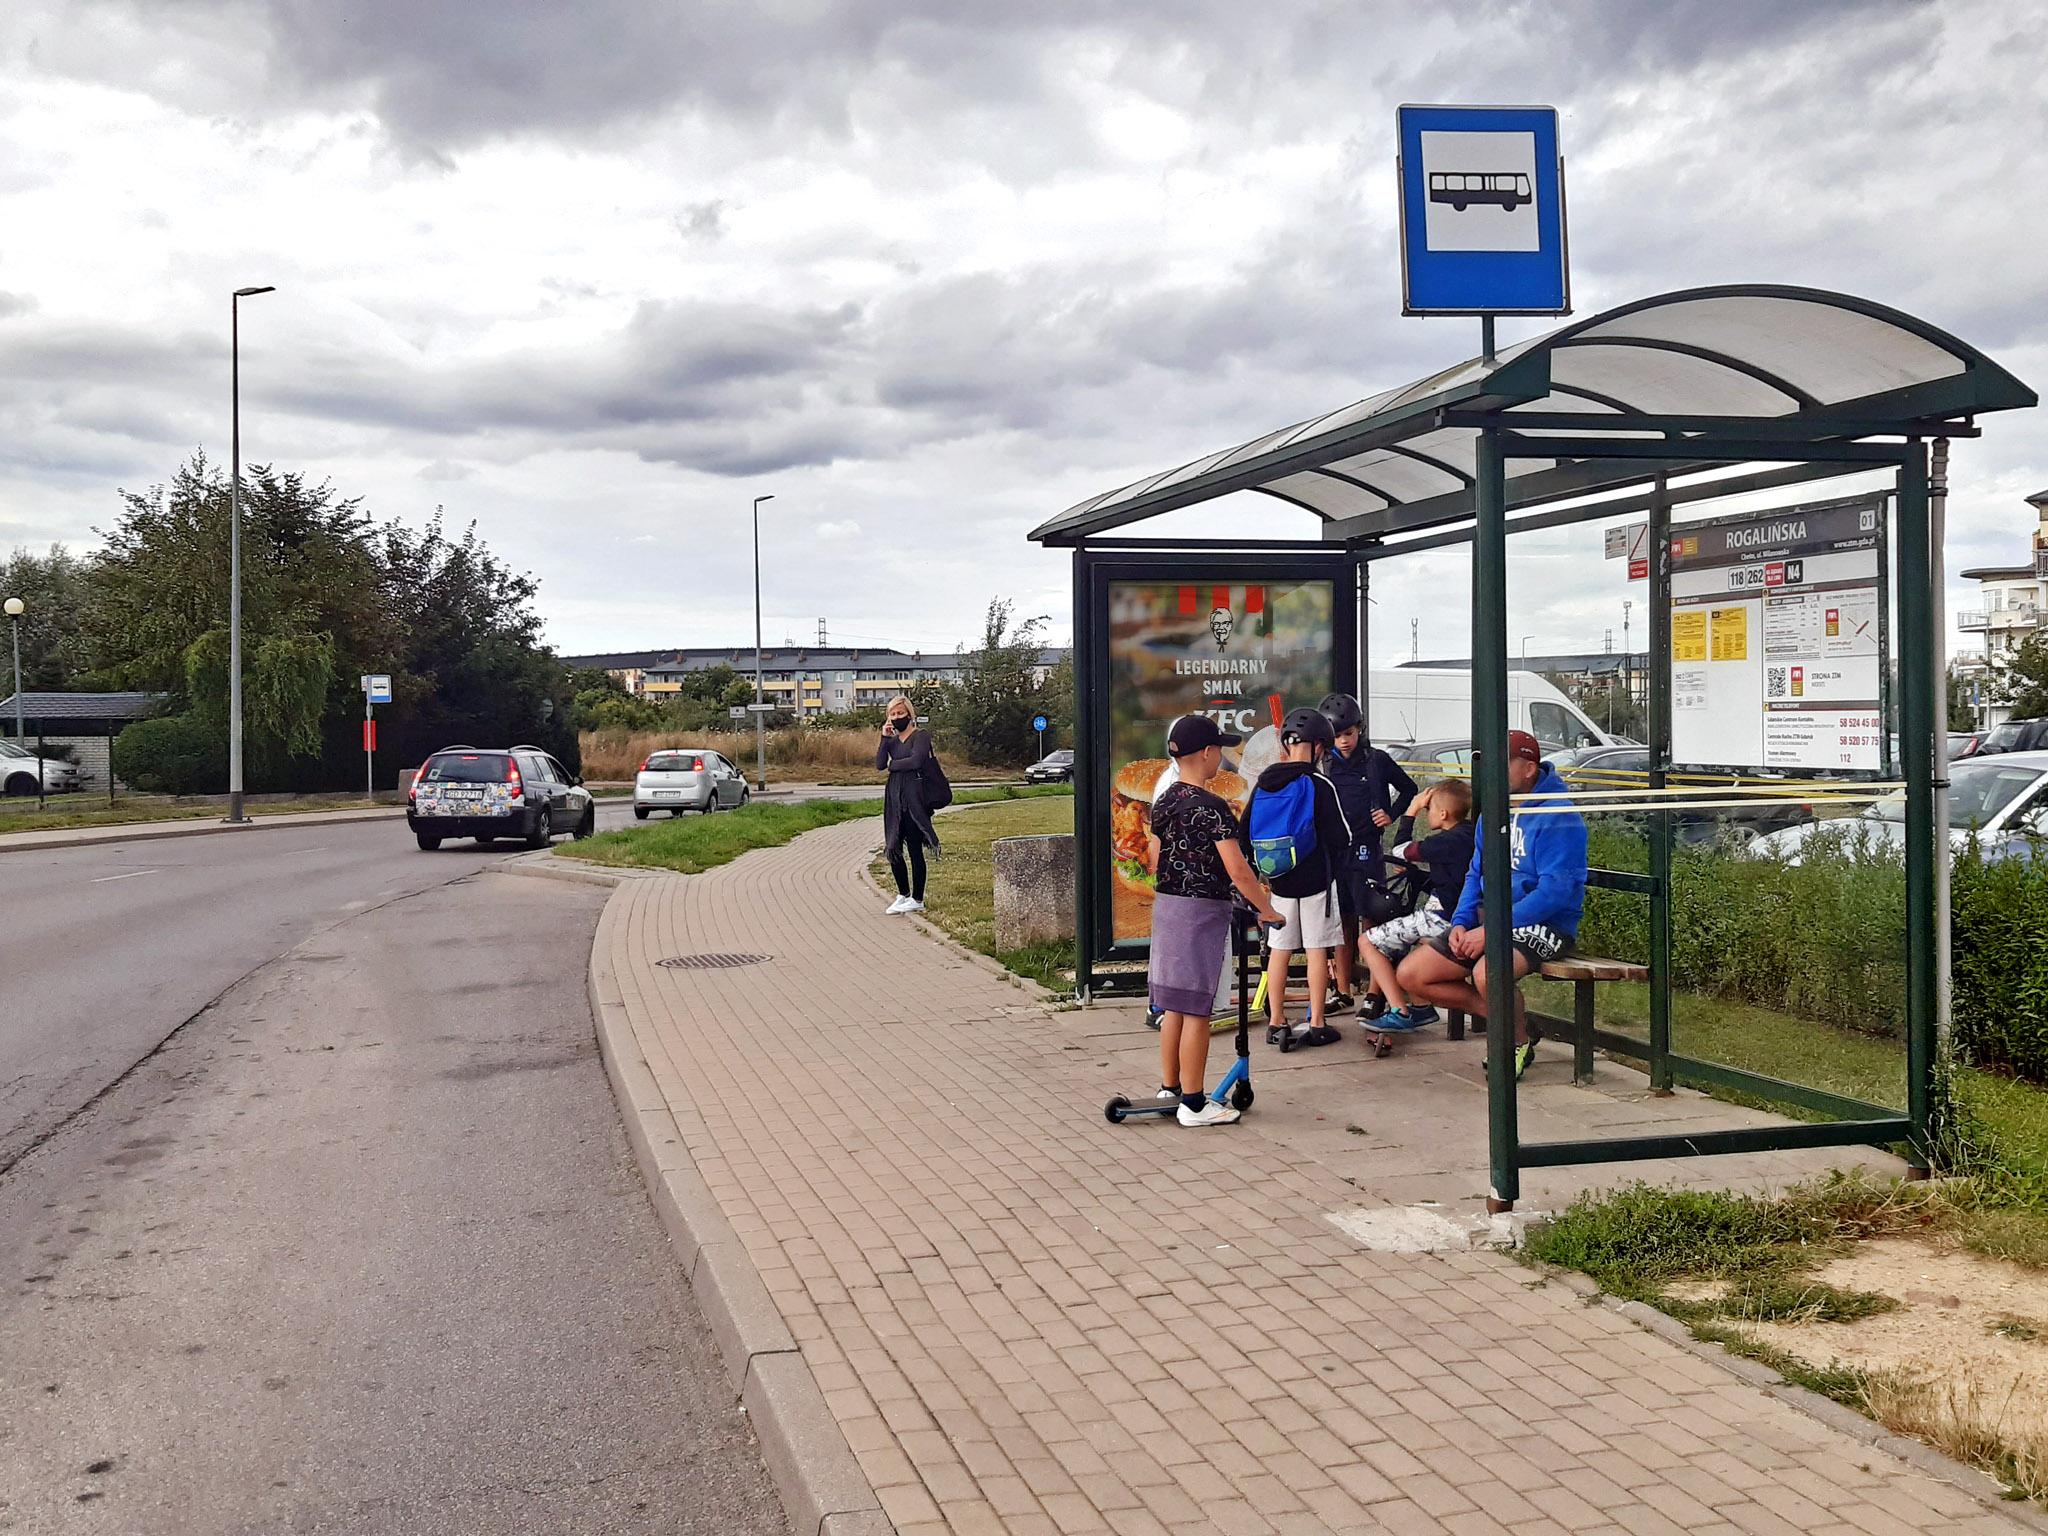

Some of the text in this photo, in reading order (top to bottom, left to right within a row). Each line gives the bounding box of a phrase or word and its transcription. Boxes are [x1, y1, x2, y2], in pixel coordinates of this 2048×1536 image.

[1861, 513, 1873, 527] 01
[1726, 521, 1807, 549] ROGALIŃSKA
[1730, 571, 1744, 586] 118
[1748, 569, 1764, 584] 262
[1787, 565, 1801, 580] N4
[1175, 659, 1268, 675] LEGENDARNY
[1203, 680, 1243, 695] SMAK
[1840, 718, 1847, 728] 58
[1848, 718, 1860, 728] 524
[1861, 718, 1870, 728] 45
[1840, 736, 1847, 746] 58
[1848, 736, 1860, 746] 520
[1861, 736, 1870, 746] 57
[1871, 736, 1879, 746] 75
[1840, 754, 1851, 763] 112
